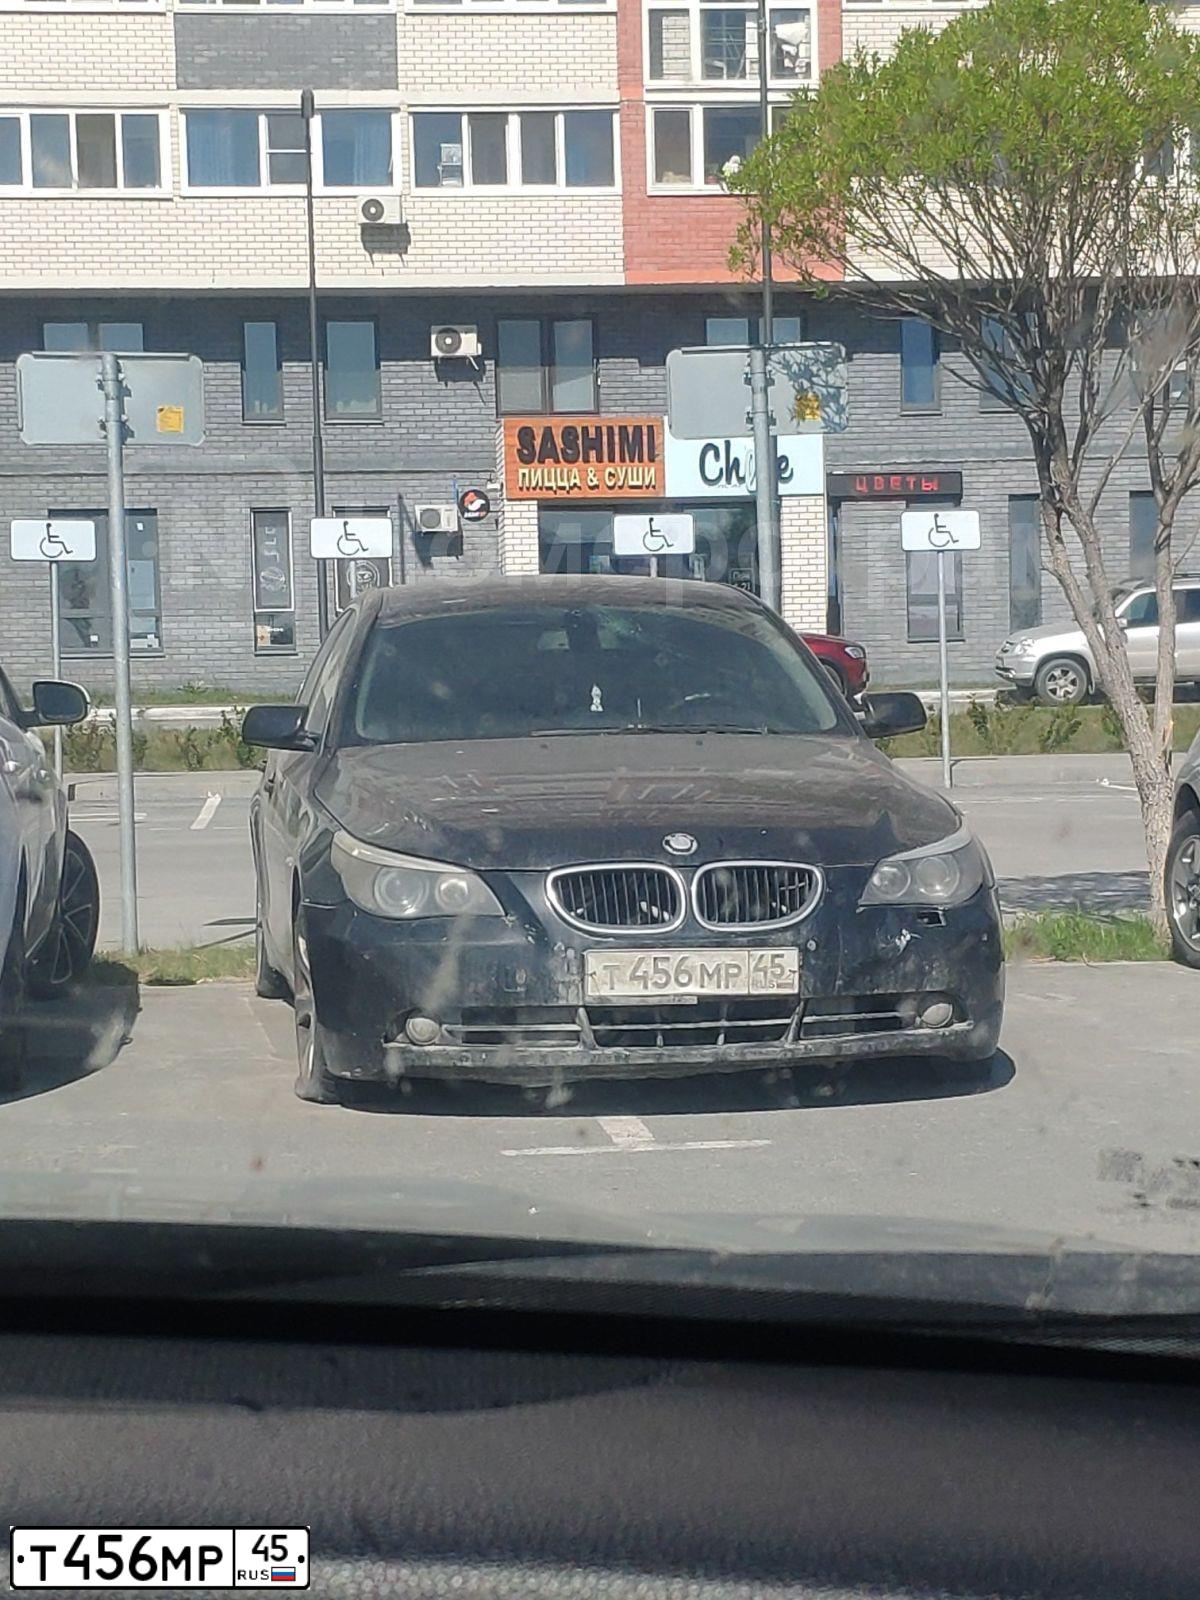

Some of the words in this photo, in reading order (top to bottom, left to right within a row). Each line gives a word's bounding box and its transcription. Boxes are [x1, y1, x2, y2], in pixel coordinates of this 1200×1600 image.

[517, 425, 656, 464] SASHIMI
[518, 467, 581, 491] ПИЦЦА
[587, 468, 599, 488] &
[604, 467, 656, 490] СУШИ
[855, 475, 939, 493] ЦВЕТЫ
